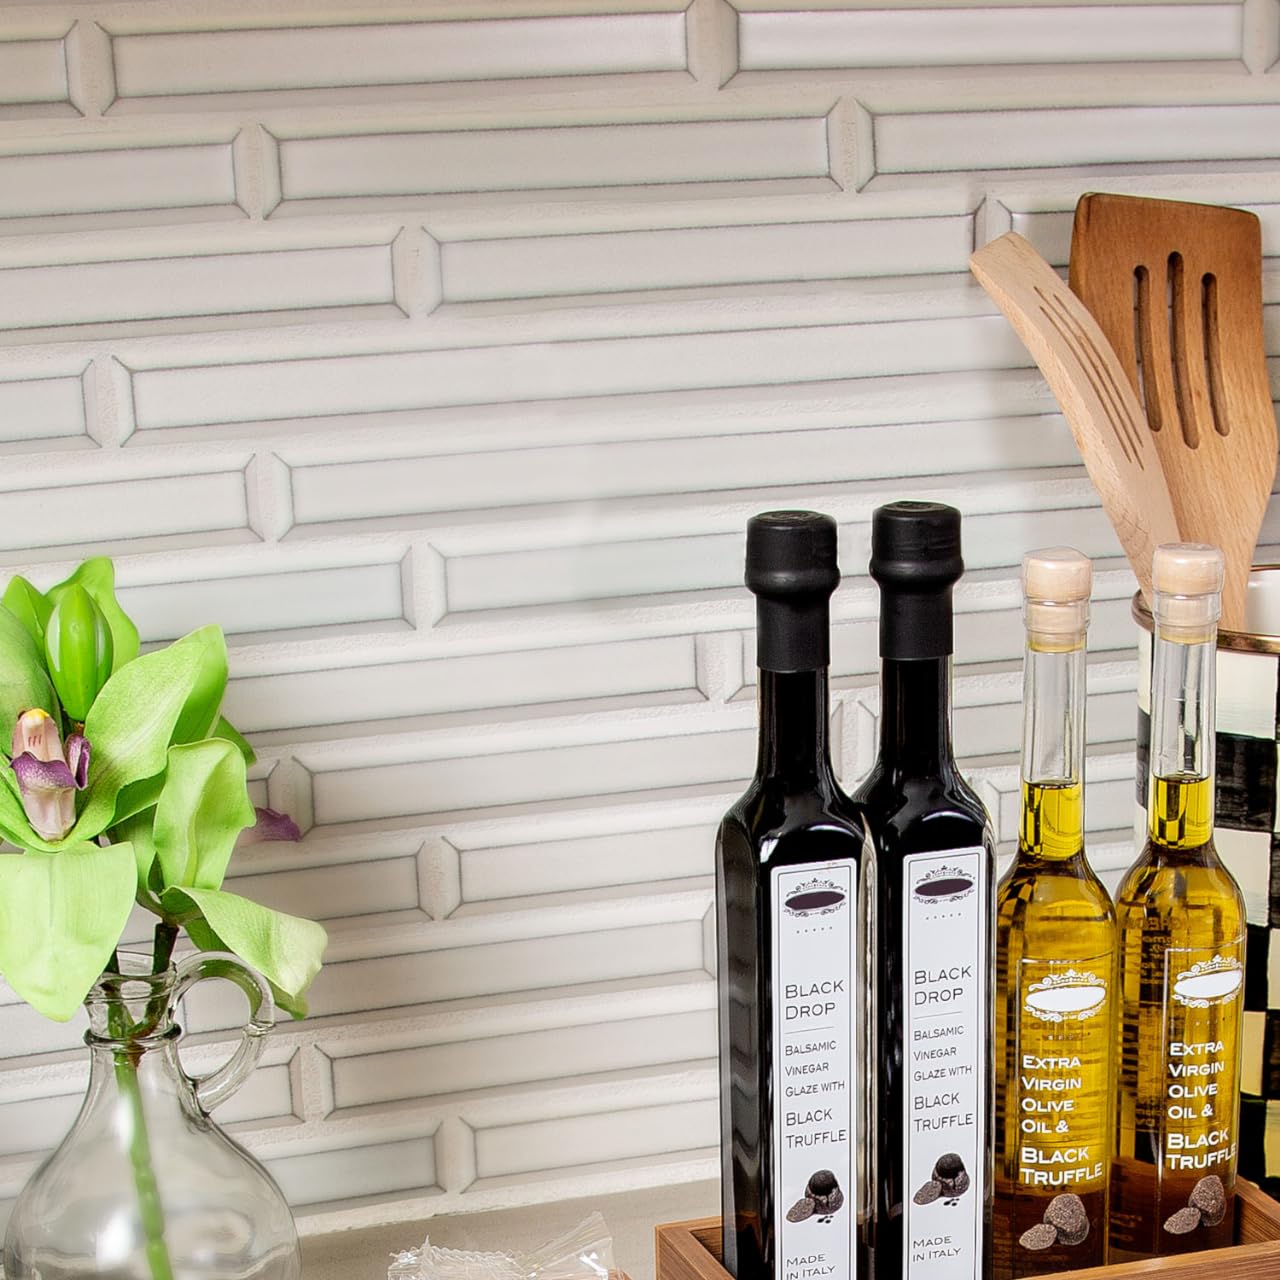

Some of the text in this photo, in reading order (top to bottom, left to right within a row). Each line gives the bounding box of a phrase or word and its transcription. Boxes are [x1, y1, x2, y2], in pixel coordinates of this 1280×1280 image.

[914, 965, 972, 985] BLACK
[785, 980, 844, 999] BLACK
[914, 987, 964, 1006] DROP
[785, 1002, 836, 1020] DROP
[914, 1025, 964, 1041] BALSAMIC
[785, 1040, 837, 1056] BALSAMIC
[913, 1047, 957, 1062] VINEGAR
[1169, 1040, 1224, 1057] EXTRA
[785, 1062, 830, 1077] VINEGAR
[1022, 1055, 1081, 1070] EXTRA
[1168, 1061, 1225, 1077] VIRGIN
[914, 1065, 973, 1082] GLAZE WITH
[785, 1080, 845, 1098] GLAZE WITH
[1021, 1076, 1082, 1091] VIRGIN
[1168, 1083, 1218, 1098] OLIVE
[914, 1092, 960, 1110] BLACK
[1021, 1098, 1074, 1112] OLIVE
[786, 1108, 833, 1126] BLACK
[1168, 1103, 1213, 1120] OIL &
[914, 1113, 974, 1133] TRUFFLE
[1021, 1119, 1069, 1134] OIL &
[786, 1129, 847, 1149] TRUFFLE
[1167, 1127, 1230, 1149] BLACK
[1021, 1146, 1089, 1164] BLACK
[1165, 1142, 1237, 1170] TRUFFLE
[1020, 1162, 1103, 1186] TRUFFLE
[913, 1236, 952, 1249] MADE
[786, 1253, 826, 1268] MADE
[913, 1247, 962, 1263] IN ITALY
[786, 1265, 836, 1280] IN ITALY
